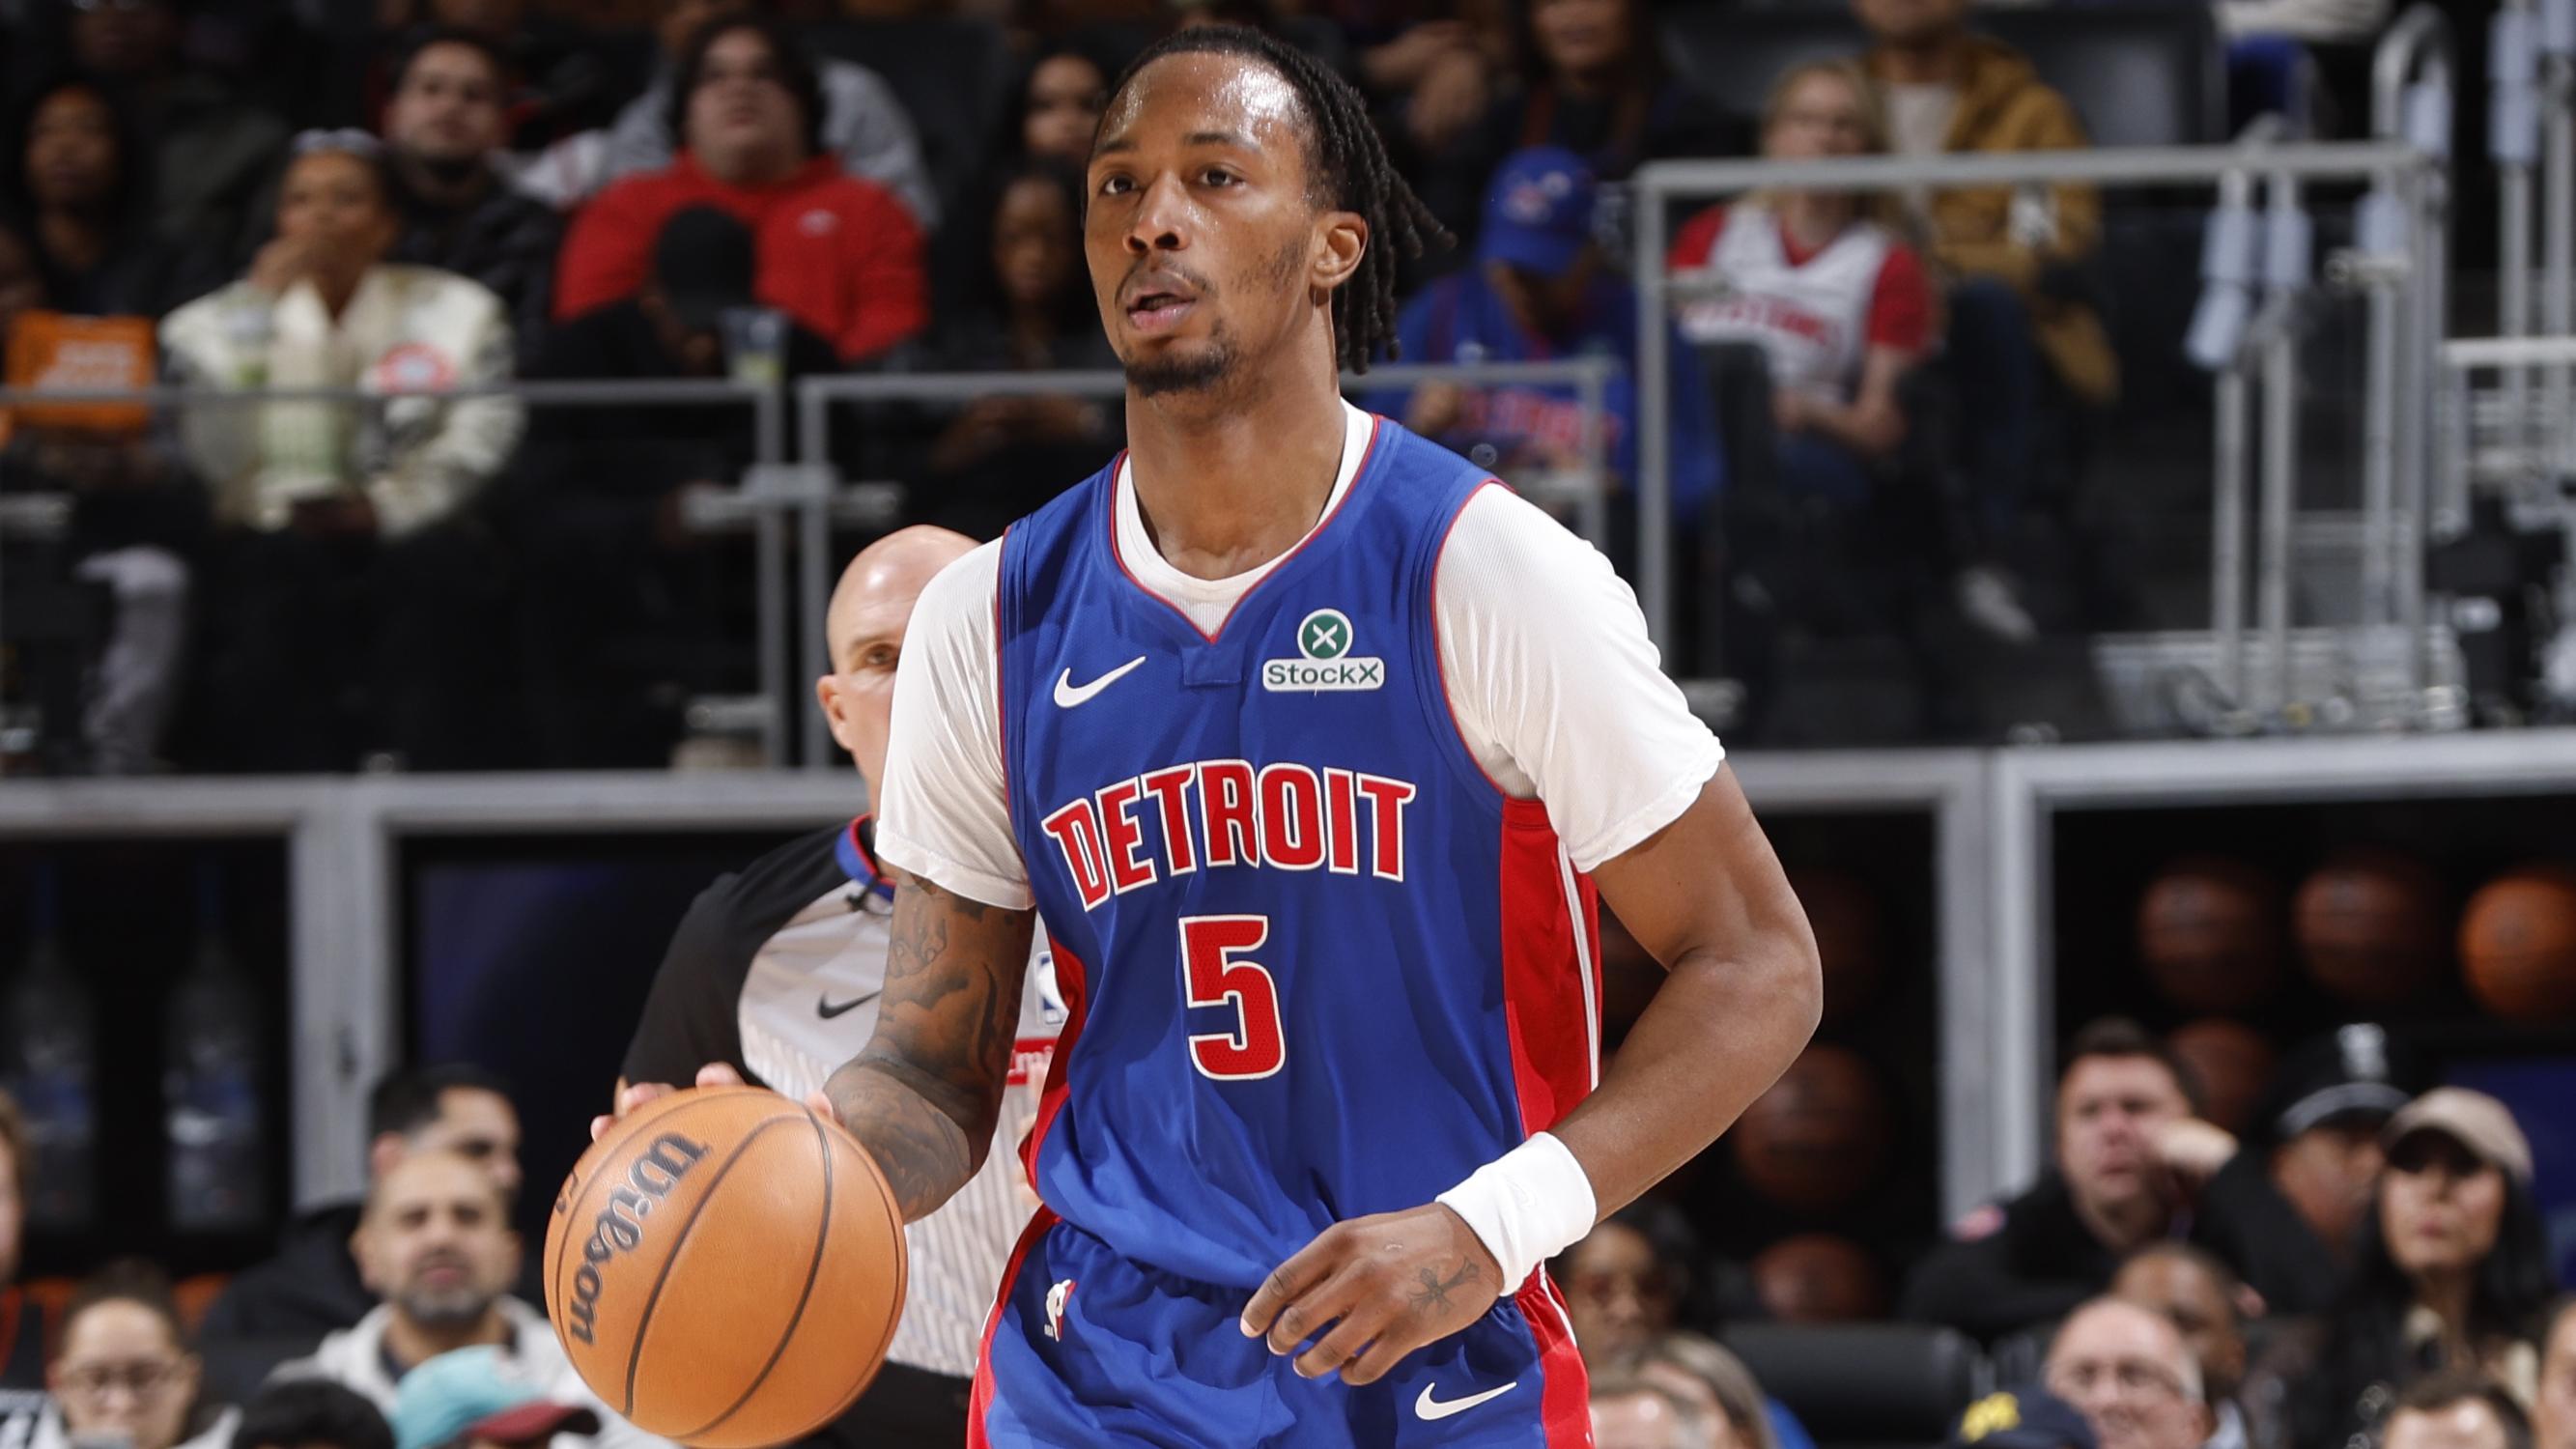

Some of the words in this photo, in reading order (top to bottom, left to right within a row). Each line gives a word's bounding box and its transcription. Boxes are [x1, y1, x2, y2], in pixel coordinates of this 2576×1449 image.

[1267, 662, 1379, 685] StockX
[1040, 758, 1417, 912] DETROIT
[1178, 915, 1286, 1080] 5
[570, 1133, 712, 1346] Wilson
